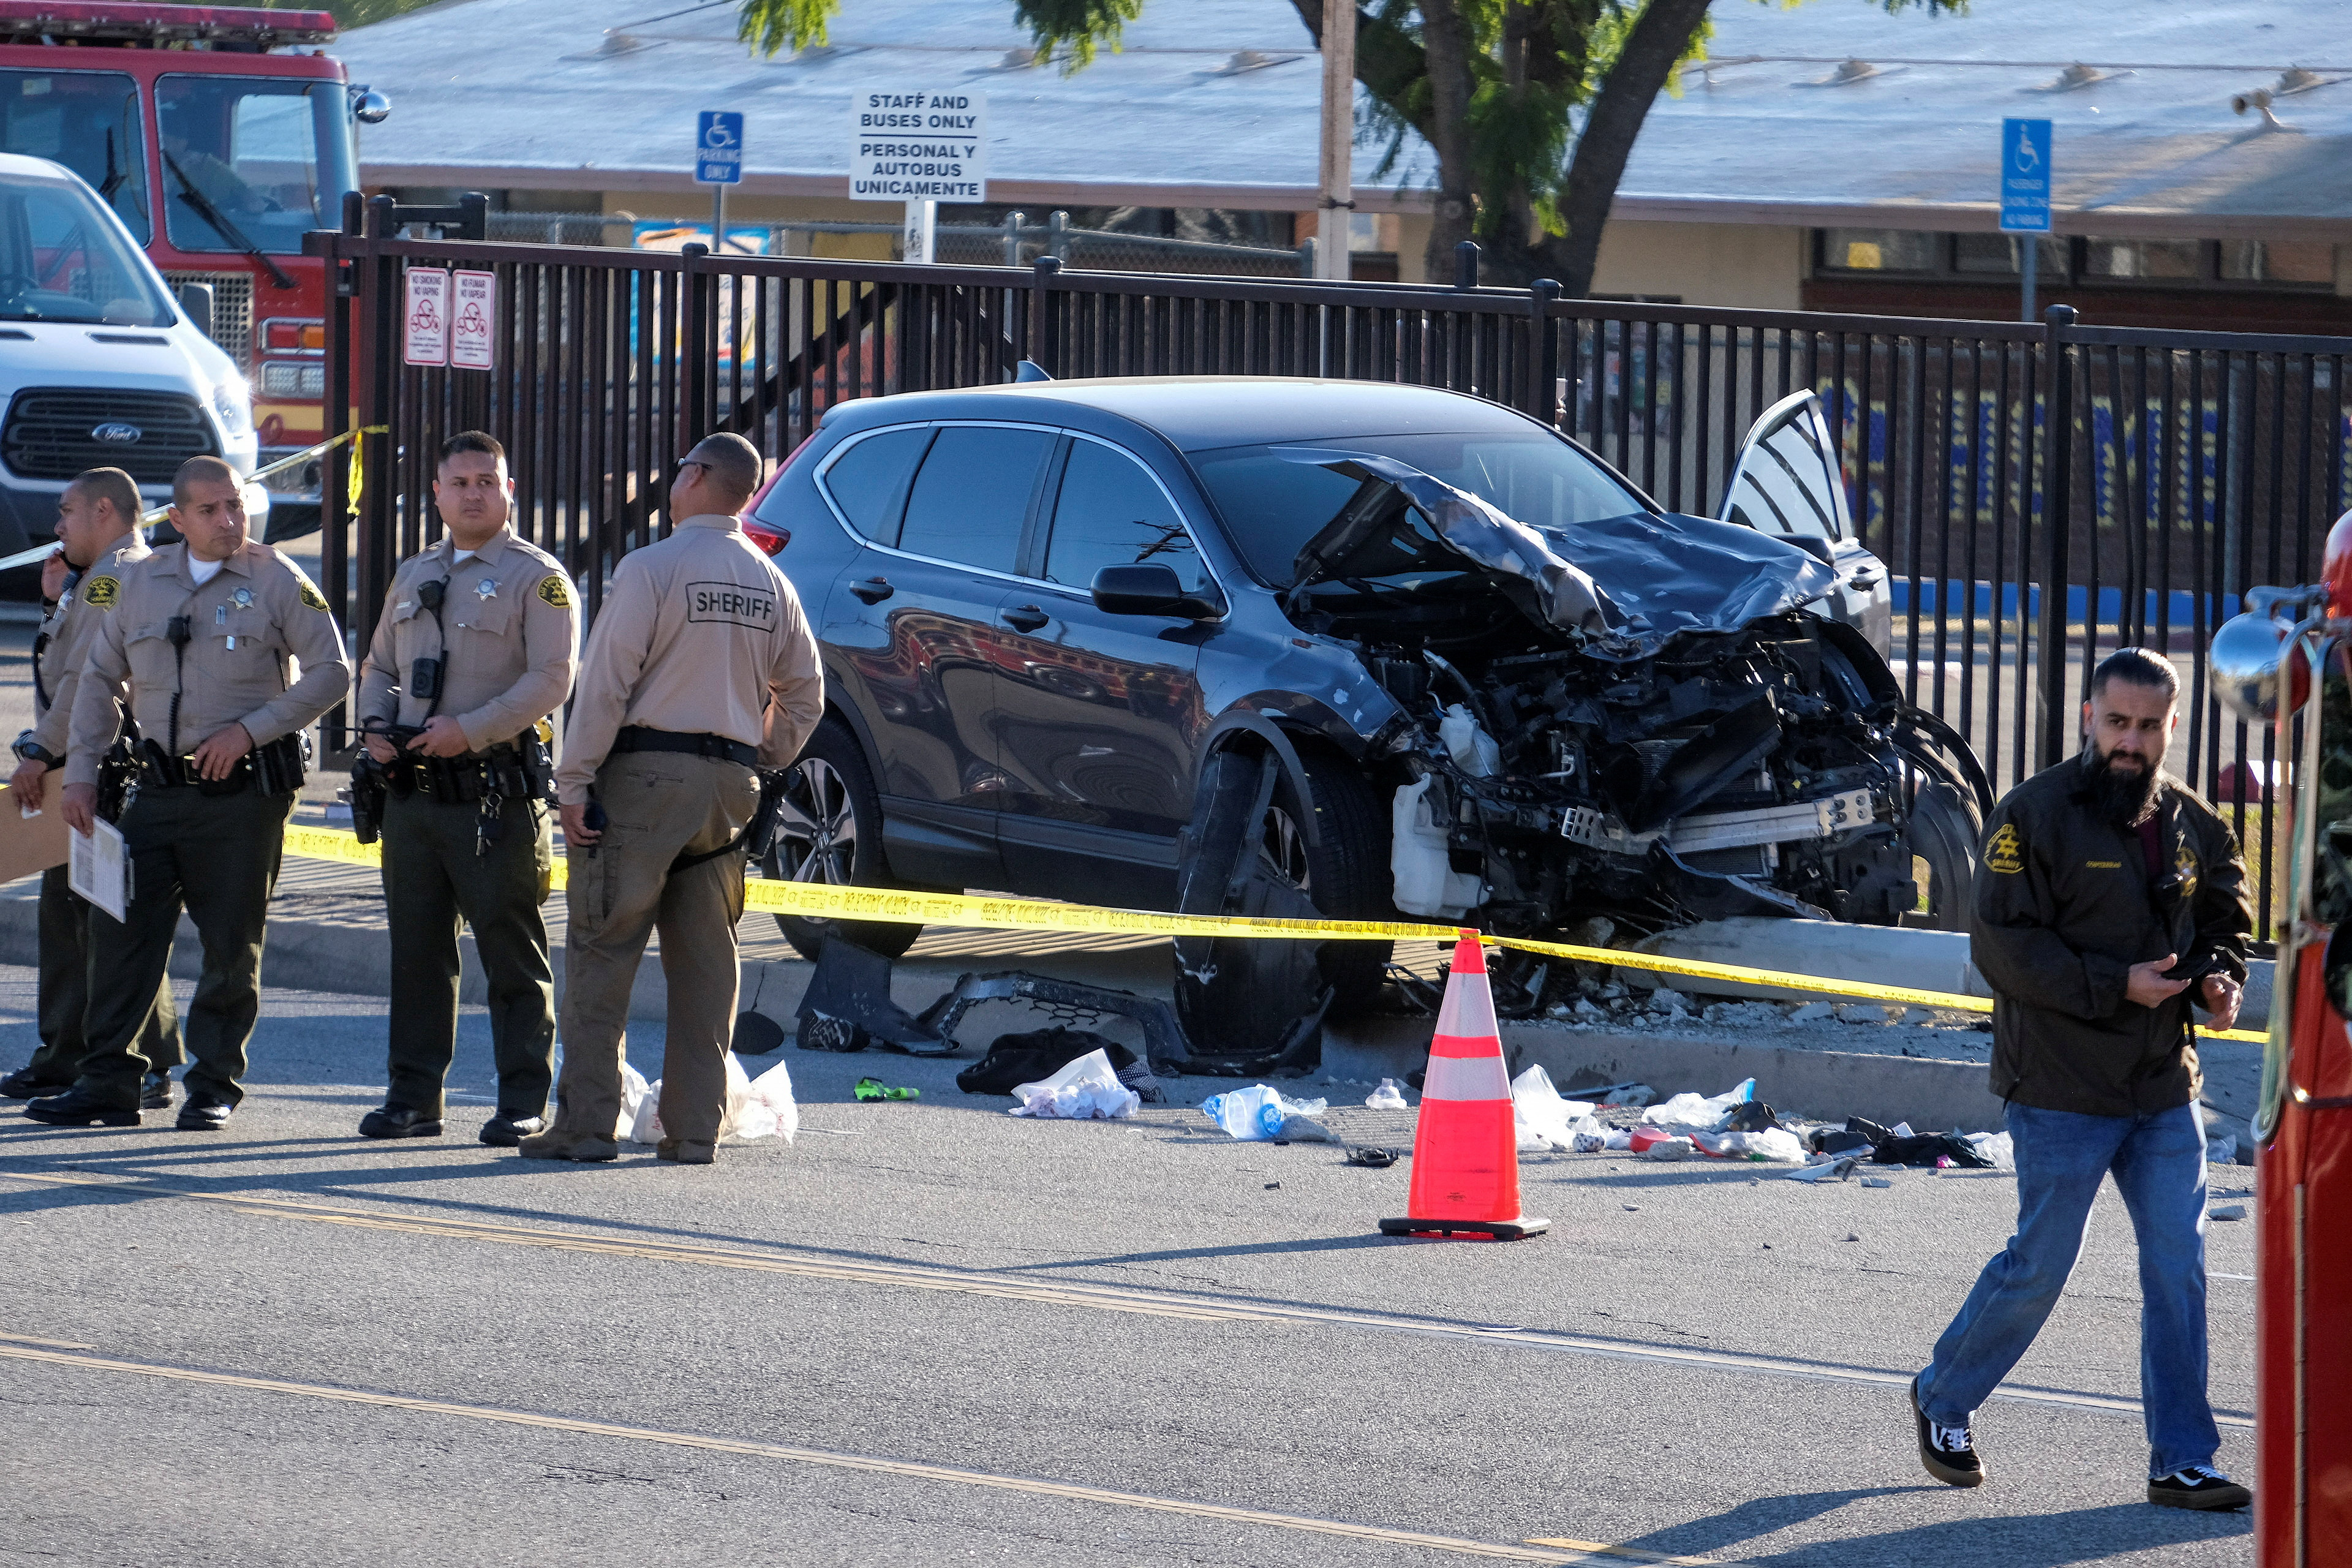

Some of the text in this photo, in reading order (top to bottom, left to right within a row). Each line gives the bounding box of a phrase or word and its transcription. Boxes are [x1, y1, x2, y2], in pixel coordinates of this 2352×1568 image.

[869, 94, 969, 109] STAFF AND
[861, 113, 977, 129] BUSES ONLY
[861, 143, 976, 158] PERSONAL Y
[872, 162, 962, 176] AUTOBUS
[855, 181, 978, 195] UNICAMENTE
[421, 276, 442, 285] SMOKING
[422, 287, 440, 296] VAPING
[104, 427, 132, 440] Ford
[696, 592, 772, 620] SHERIFF
